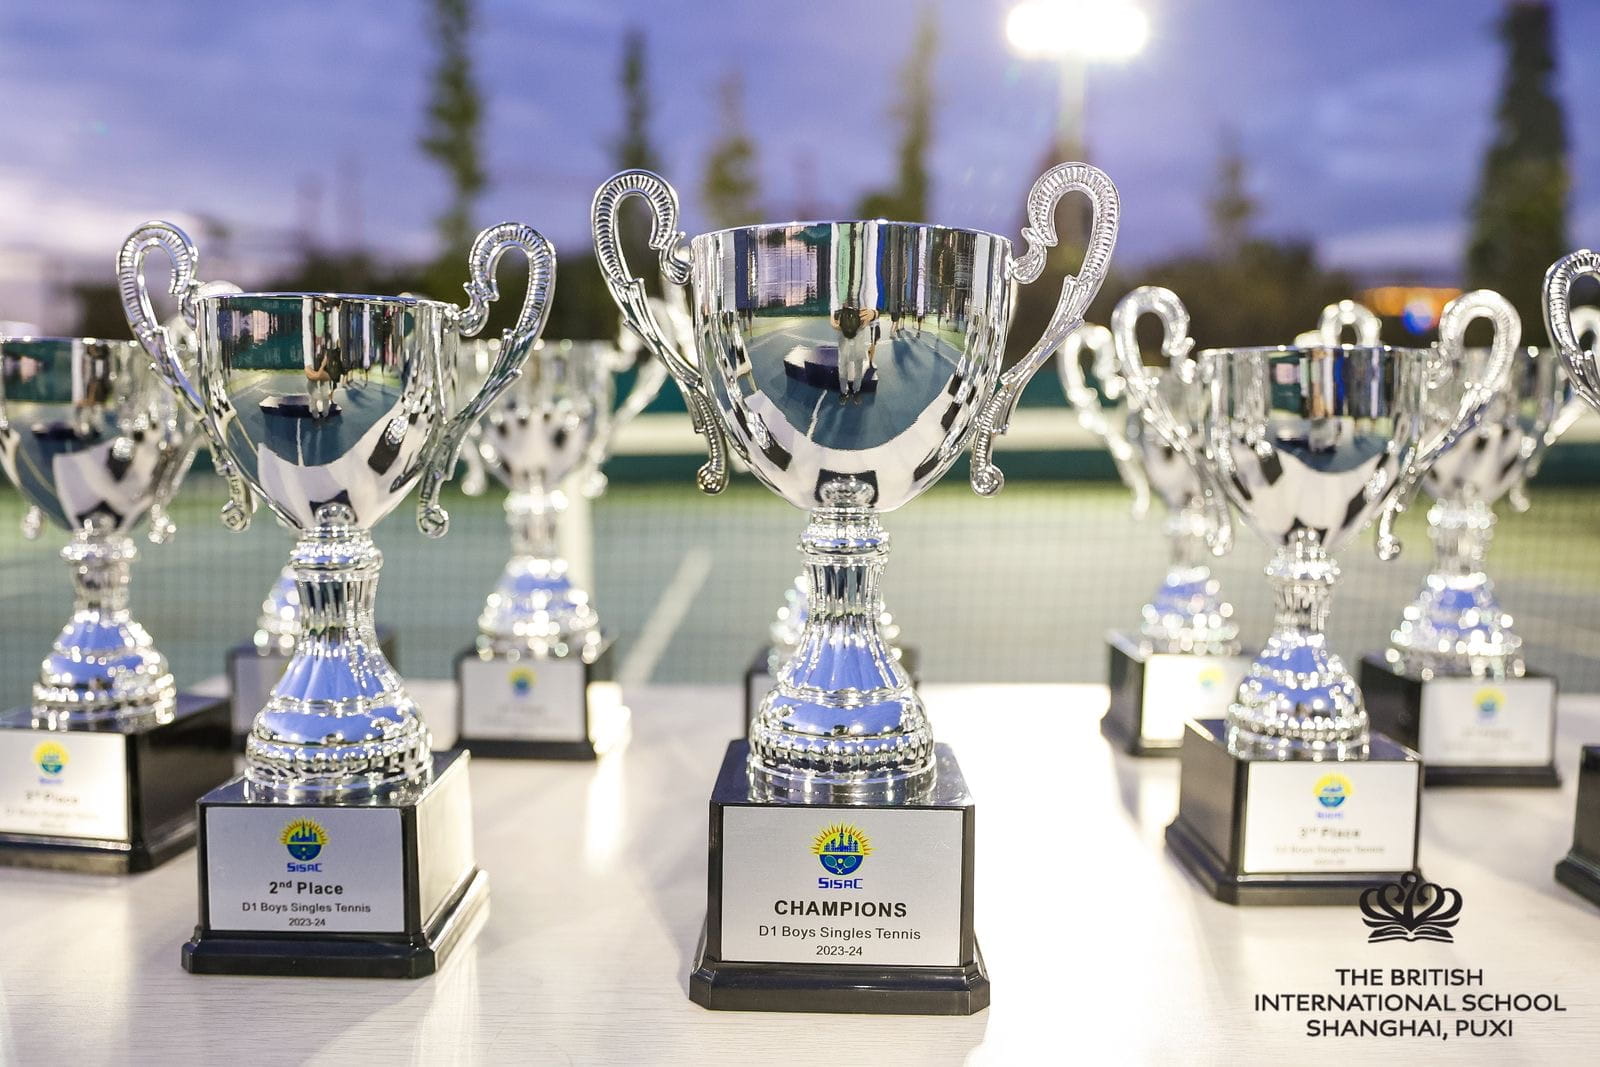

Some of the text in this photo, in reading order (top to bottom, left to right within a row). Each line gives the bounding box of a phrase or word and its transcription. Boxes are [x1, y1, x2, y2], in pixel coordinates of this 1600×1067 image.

[269, 880, 344, 895] 2nd Place
[242, 902, 371, 914] D1 Boys Singles Tennis
[774, 899, 908, 918] CHAMPIONS
[288, 917, 326, 927] 2023-24
[759, 925, 921, 941] D1 Boys Singles Tennis
[816, 945, 863, 956] 2023-24
